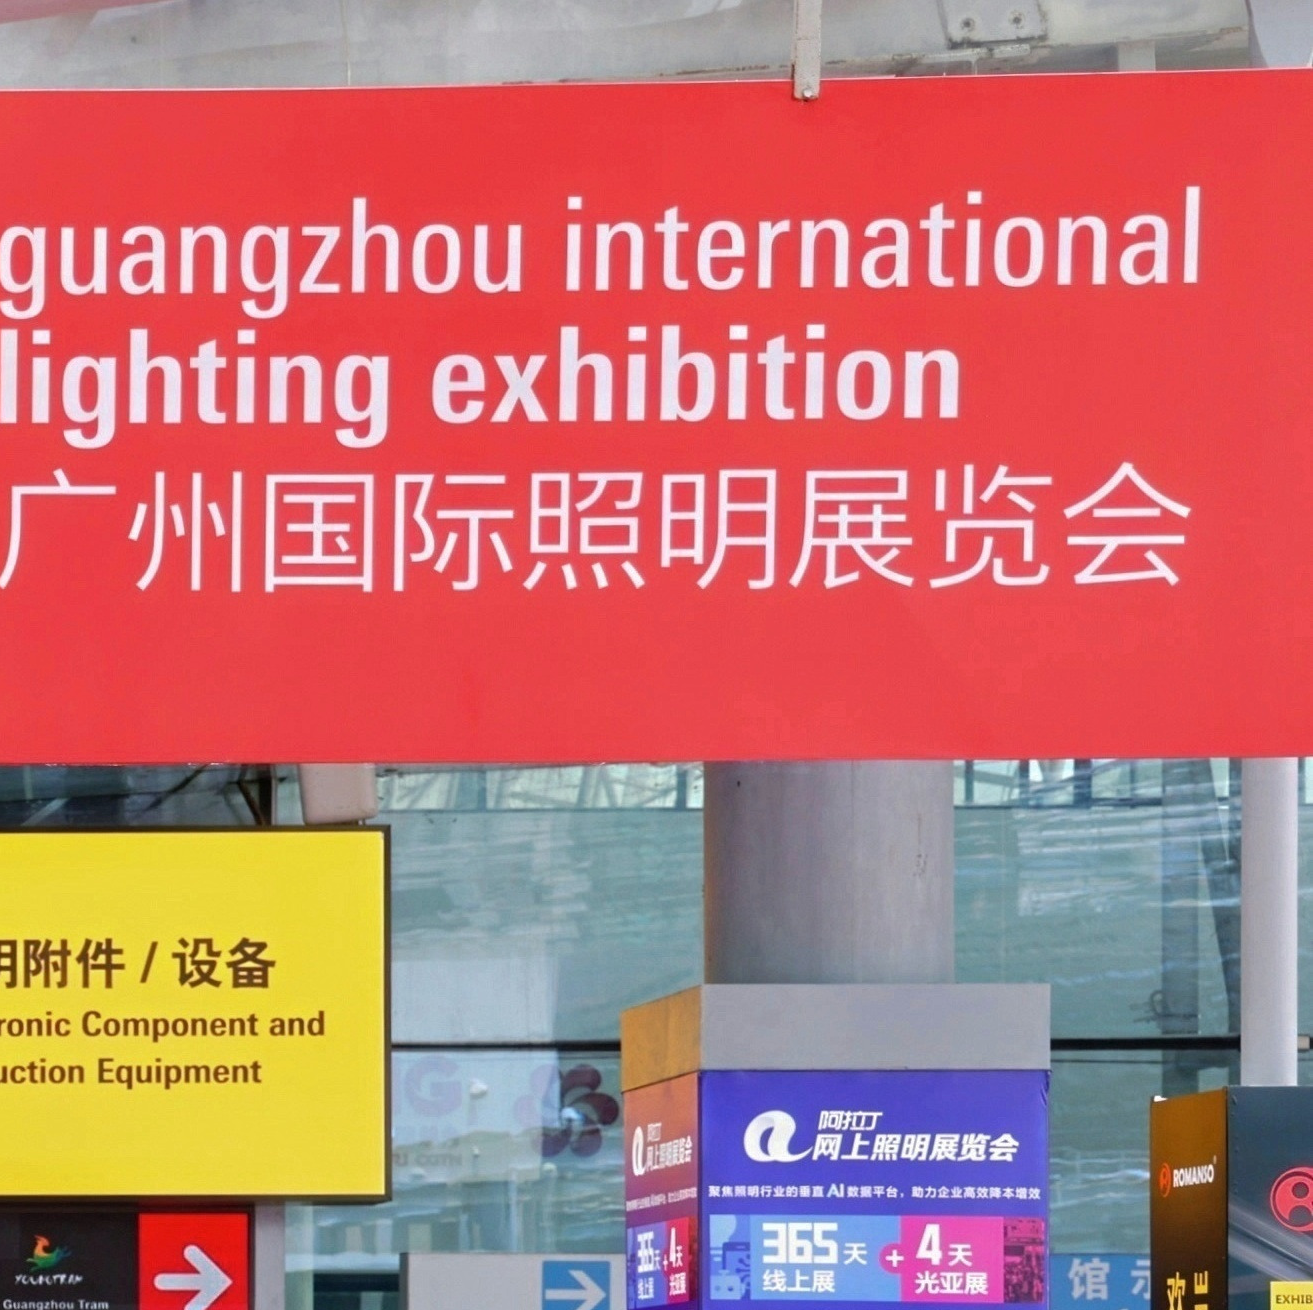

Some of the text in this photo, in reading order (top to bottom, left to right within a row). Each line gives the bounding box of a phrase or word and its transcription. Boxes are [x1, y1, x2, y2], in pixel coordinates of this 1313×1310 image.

[566, 186, 1201, 291] international
[430, 324, 961, 424] exhibition
[172, 937, 277, 989] 设备
[82, 1010, 259, 1043] Component
[269, 1010, 326, 1038] and
[97, 1057, 262, 1090] Equipment
[817, 1109, 884, 1131] 阿拉丁
[811, 1133, 1020, 1163] 网上照明展览会
[1173, 1163, 1215, 1188] ROMANSO
[762, 1222, 838, 1264] 365
[843, 1243, 868, 1265] 天
[915, 1223, 943, 1266] 4
[947, 1243, 973, 1267] 天
[762, 1269, 989, 1295] 线上展 光亚展
[77, 1299, 110, 1310] Tram
